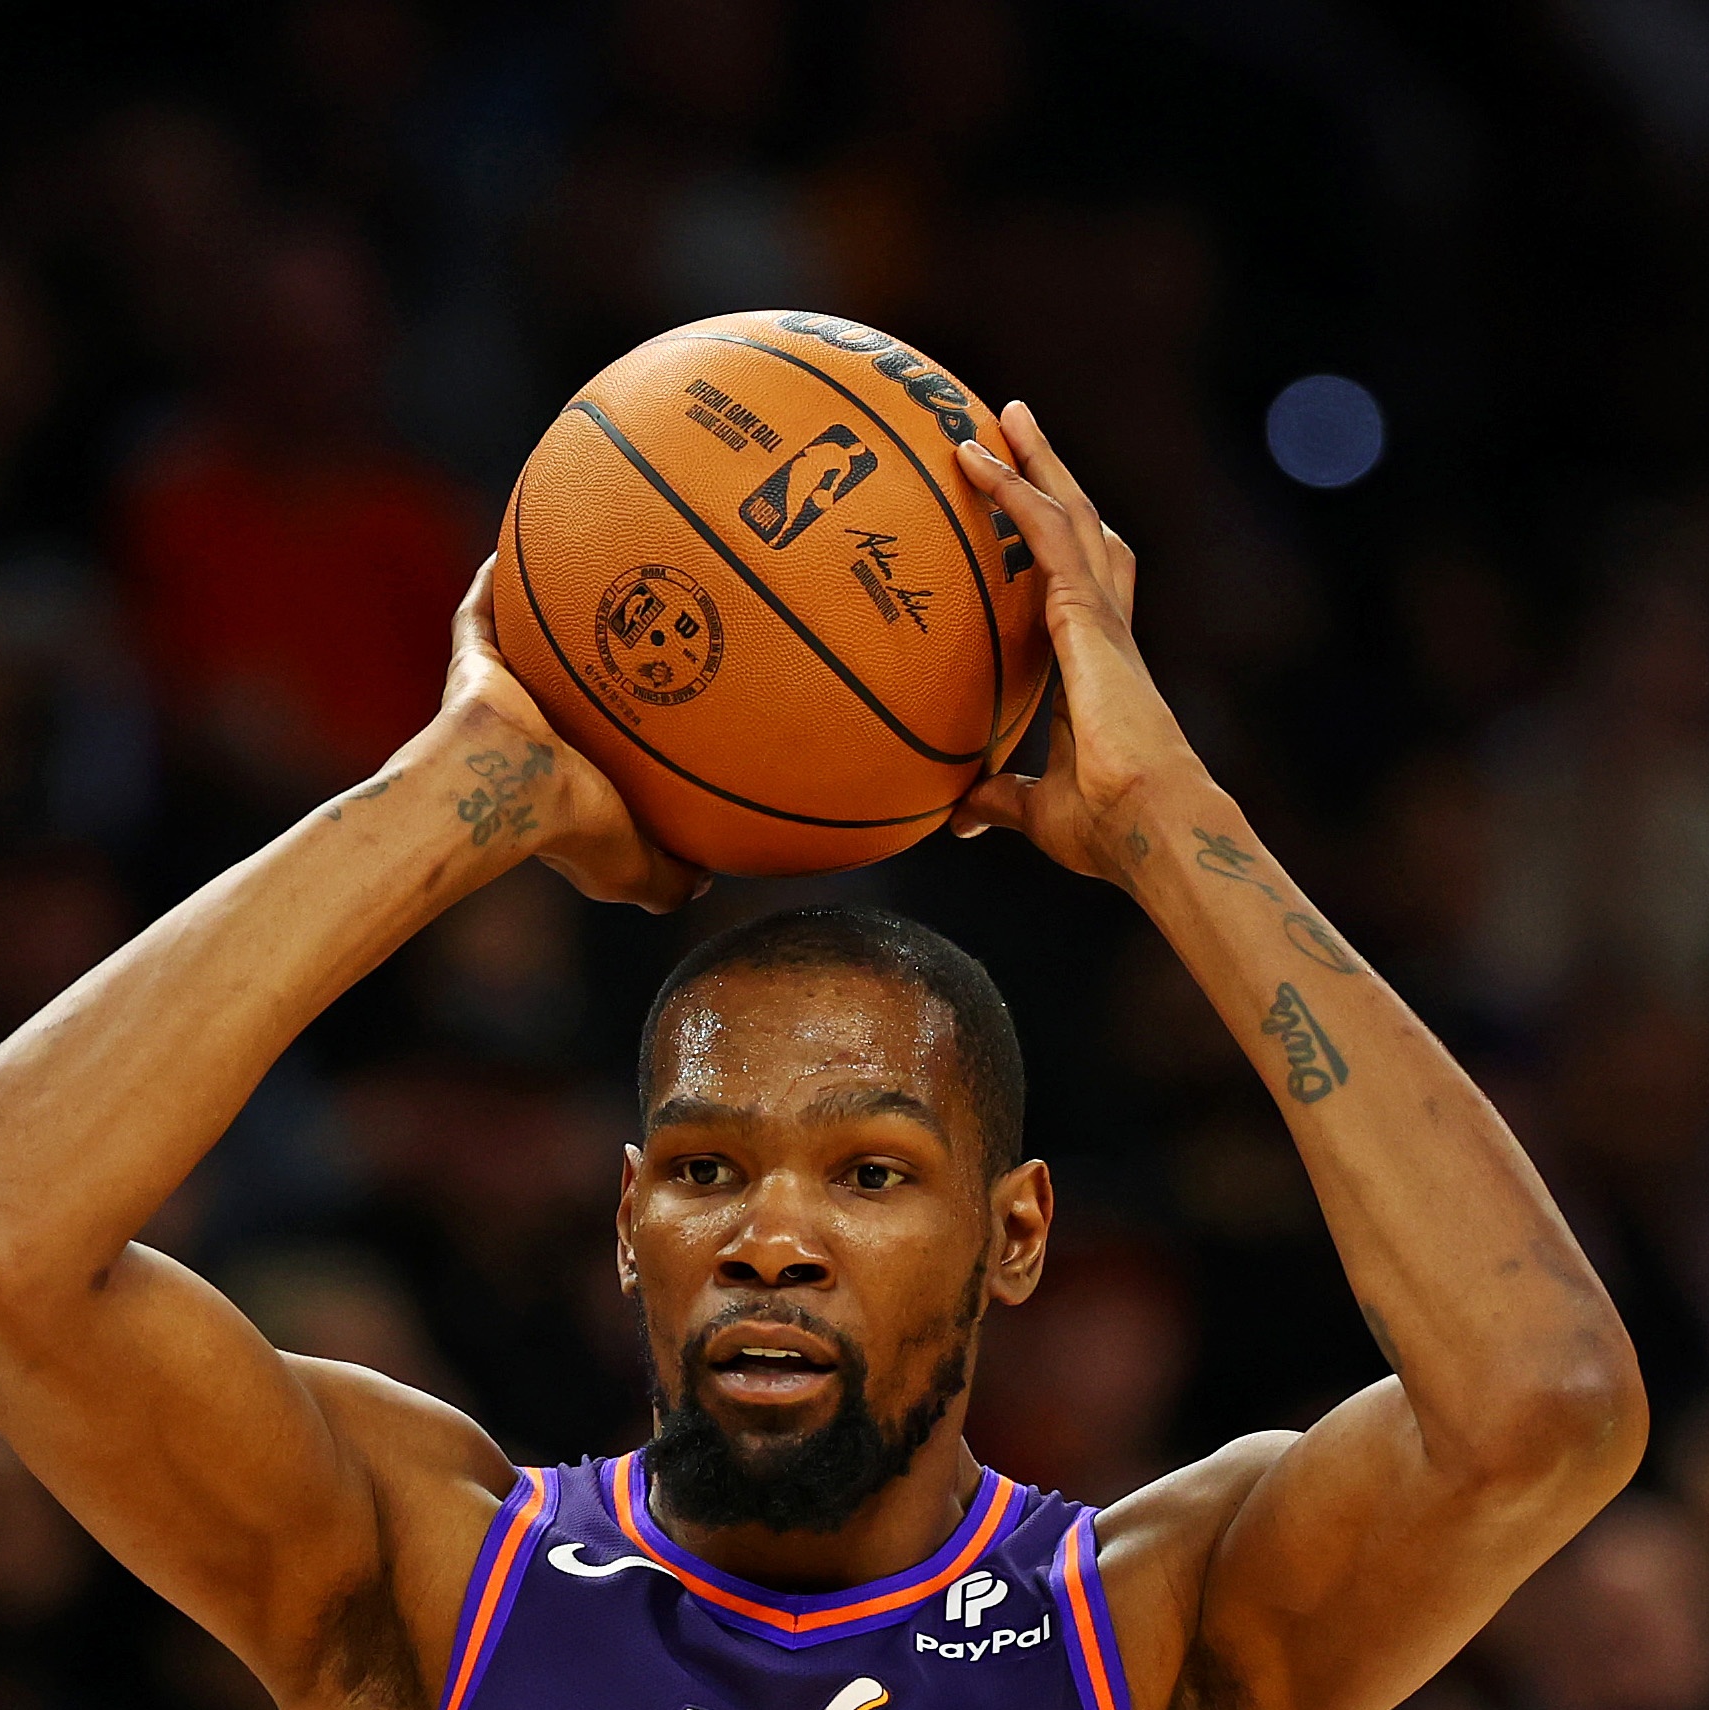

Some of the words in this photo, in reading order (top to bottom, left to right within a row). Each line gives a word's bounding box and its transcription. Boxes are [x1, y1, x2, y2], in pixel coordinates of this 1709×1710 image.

[685, 379, 733, 413] OFFICIAL
[724, 403, 761, 433] GAME
[750, 424, 783, 453] BALL
[748, 496, 781, 532] NBA
[916, 1613, 1051, 1662] PayPal
